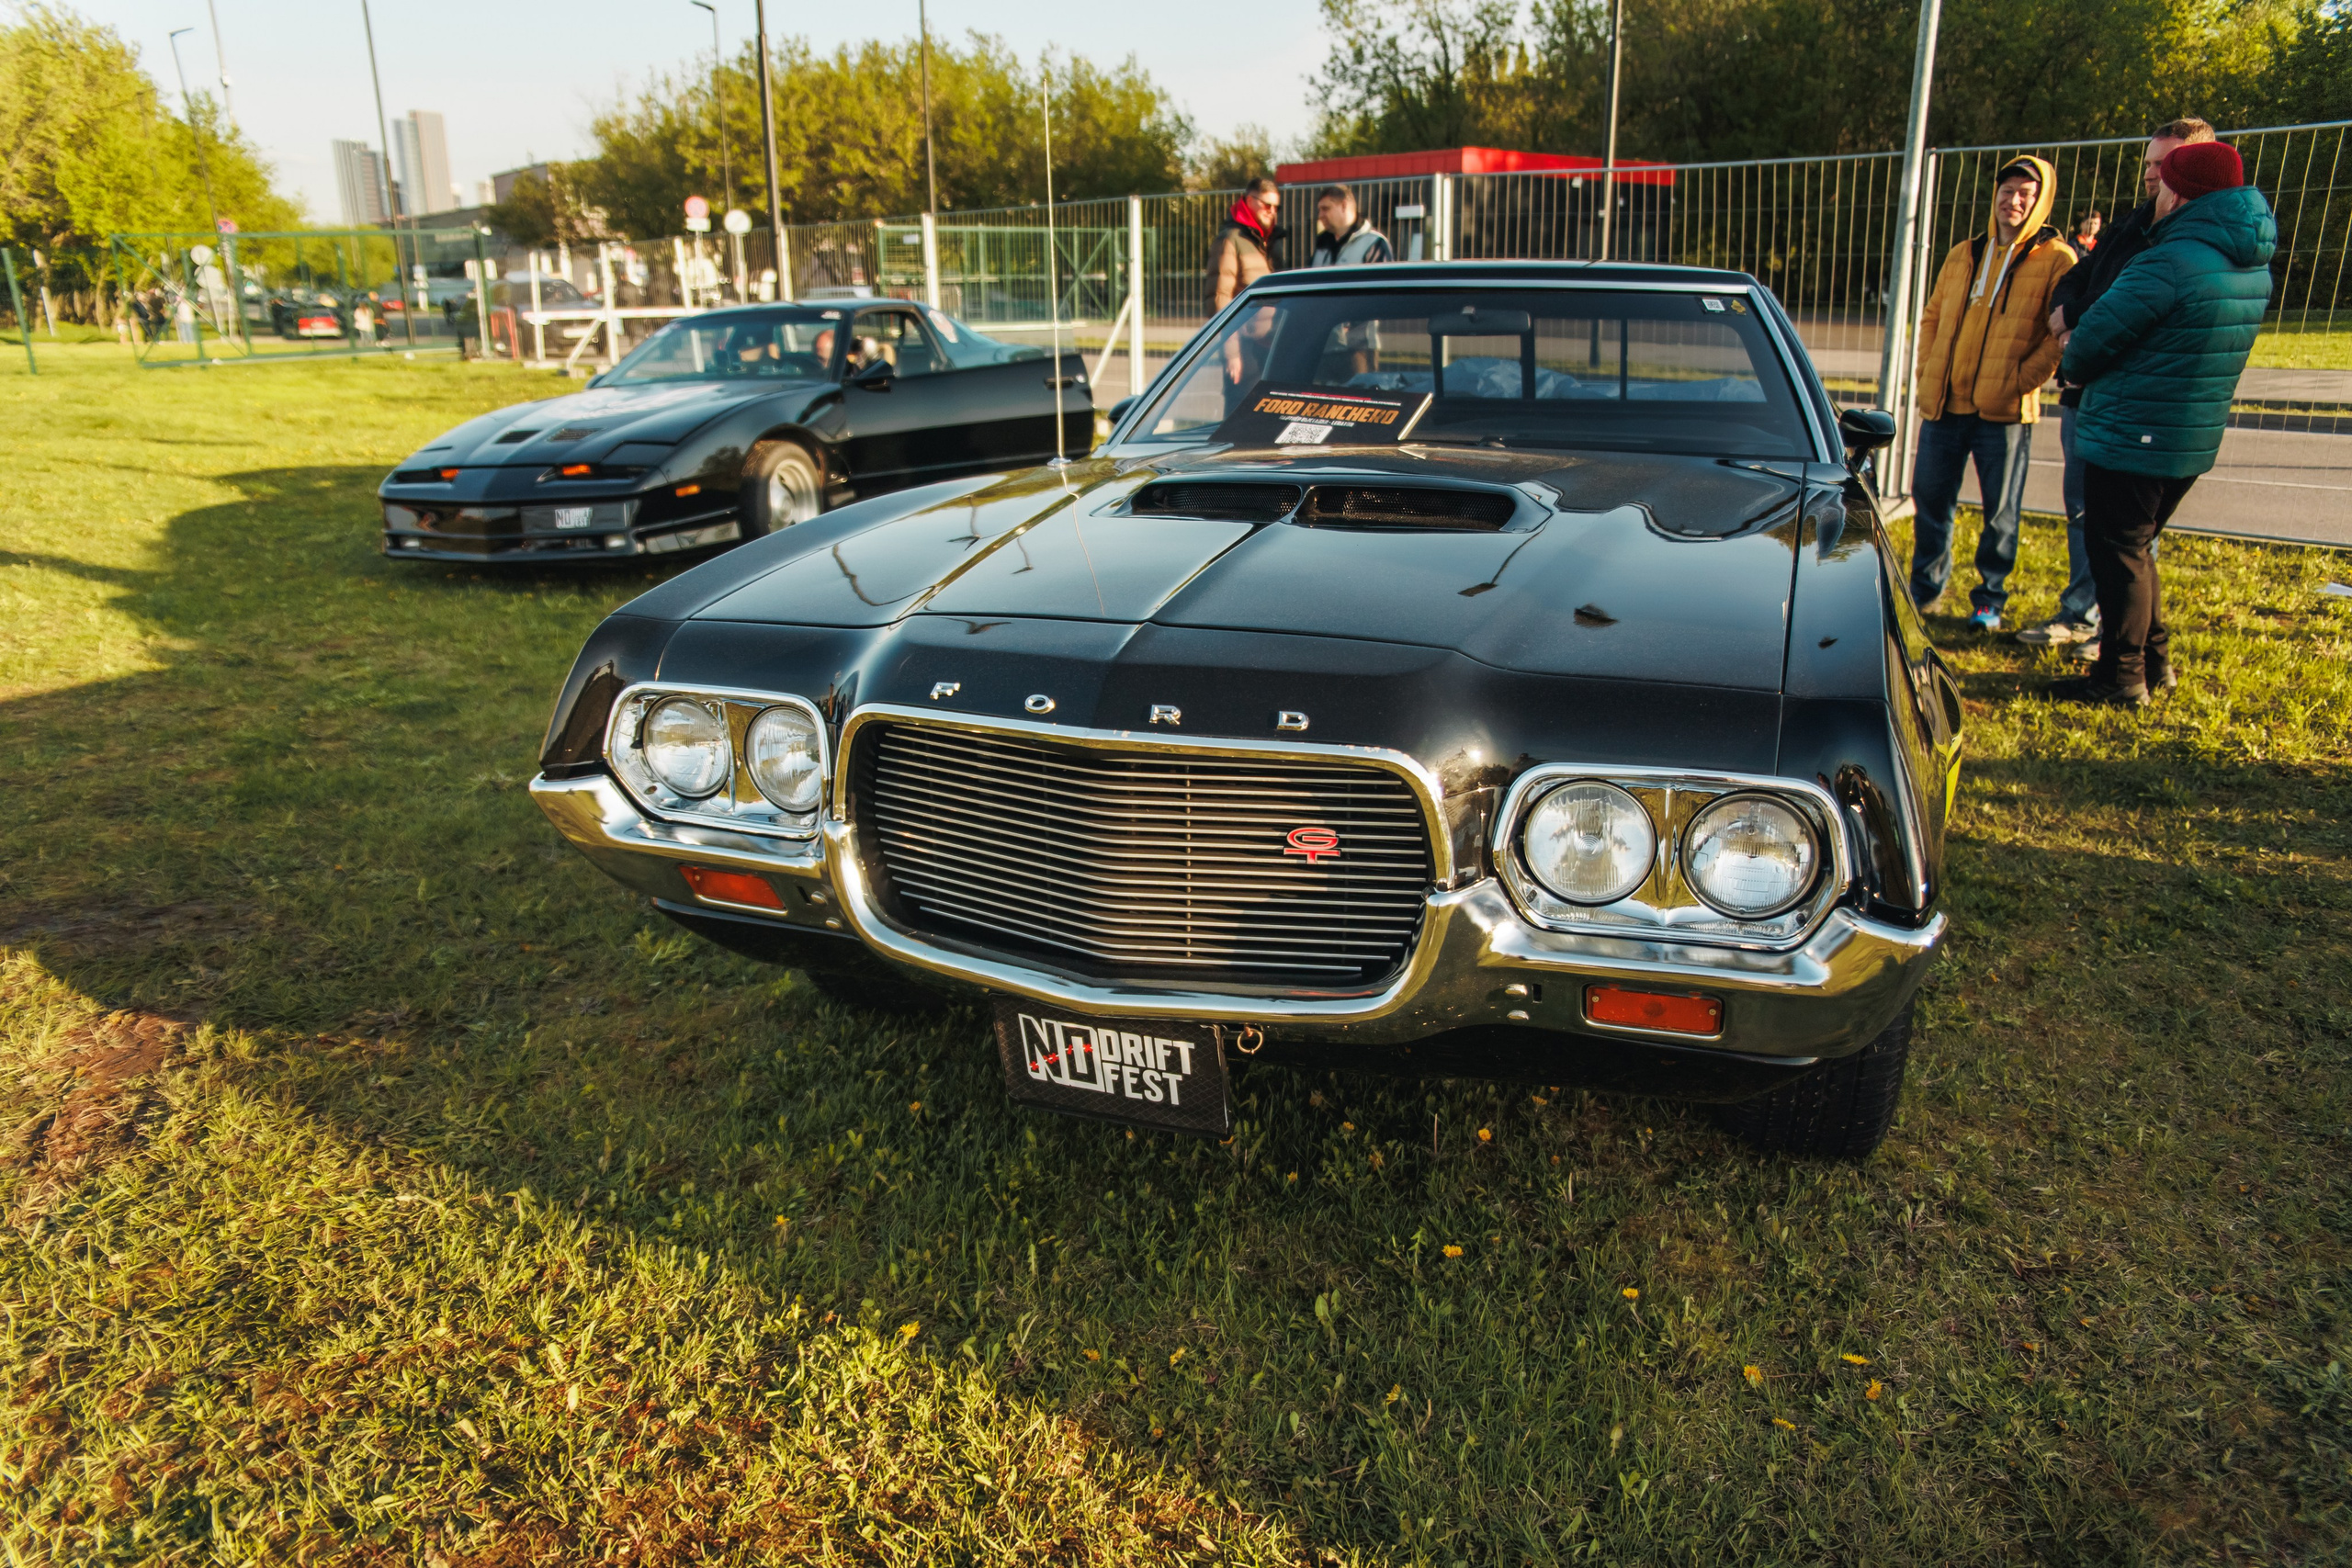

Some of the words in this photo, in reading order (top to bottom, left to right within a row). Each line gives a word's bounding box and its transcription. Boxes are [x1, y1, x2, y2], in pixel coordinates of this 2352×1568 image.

[1253, 398, 1306, 416] FORD
[1300, 402, 1399, 425] RANCHERO
[930, 682, 1310, 731] FORD
[1283, 828, 1341, 864] GT
[1098, 1028, 1195, 1075] DRIFT
[1102, 1062, 1183, 1105] FEST
